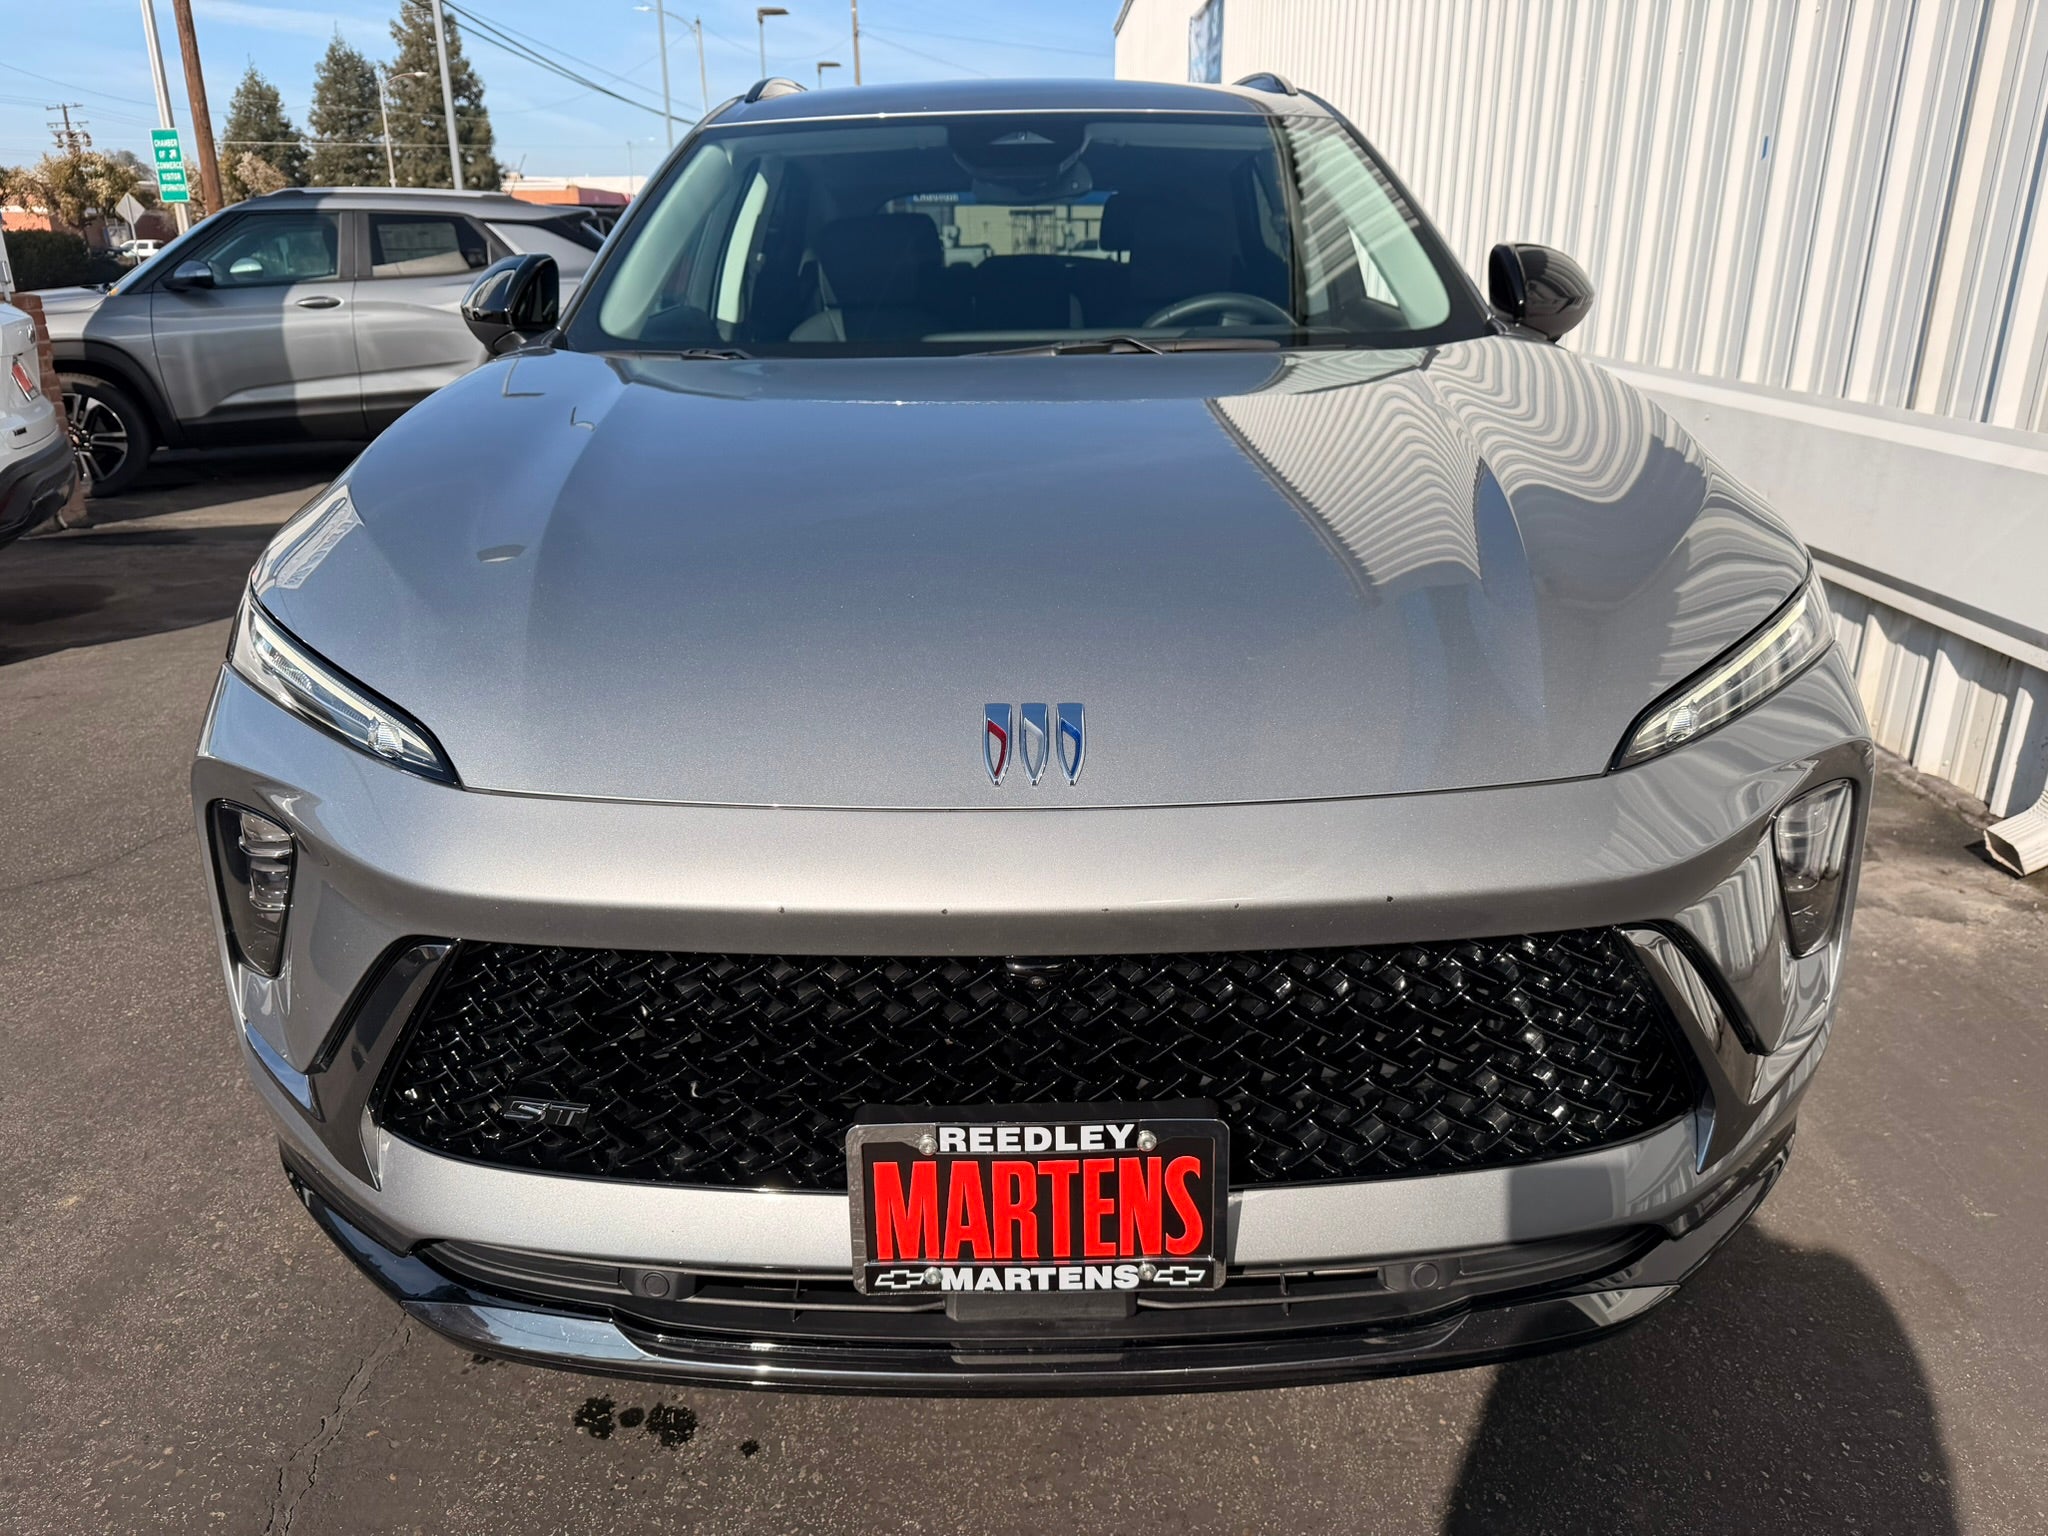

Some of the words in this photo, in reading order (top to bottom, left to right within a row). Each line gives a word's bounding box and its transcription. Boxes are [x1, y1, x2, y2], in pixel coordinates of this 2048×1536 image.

[154, 138, 178, 148] CHAMBER
[158, 150, 166, 159] OF
[157, 161, 183, 170] COMMERCE
[161, 172, 182, 181] VISITOR
[939, 1124, 1135, 1153] REEDLEY
[872, 1155, 1204, 1260] MARTENS
[941, 1264, 1140, 1291] MARTENS
